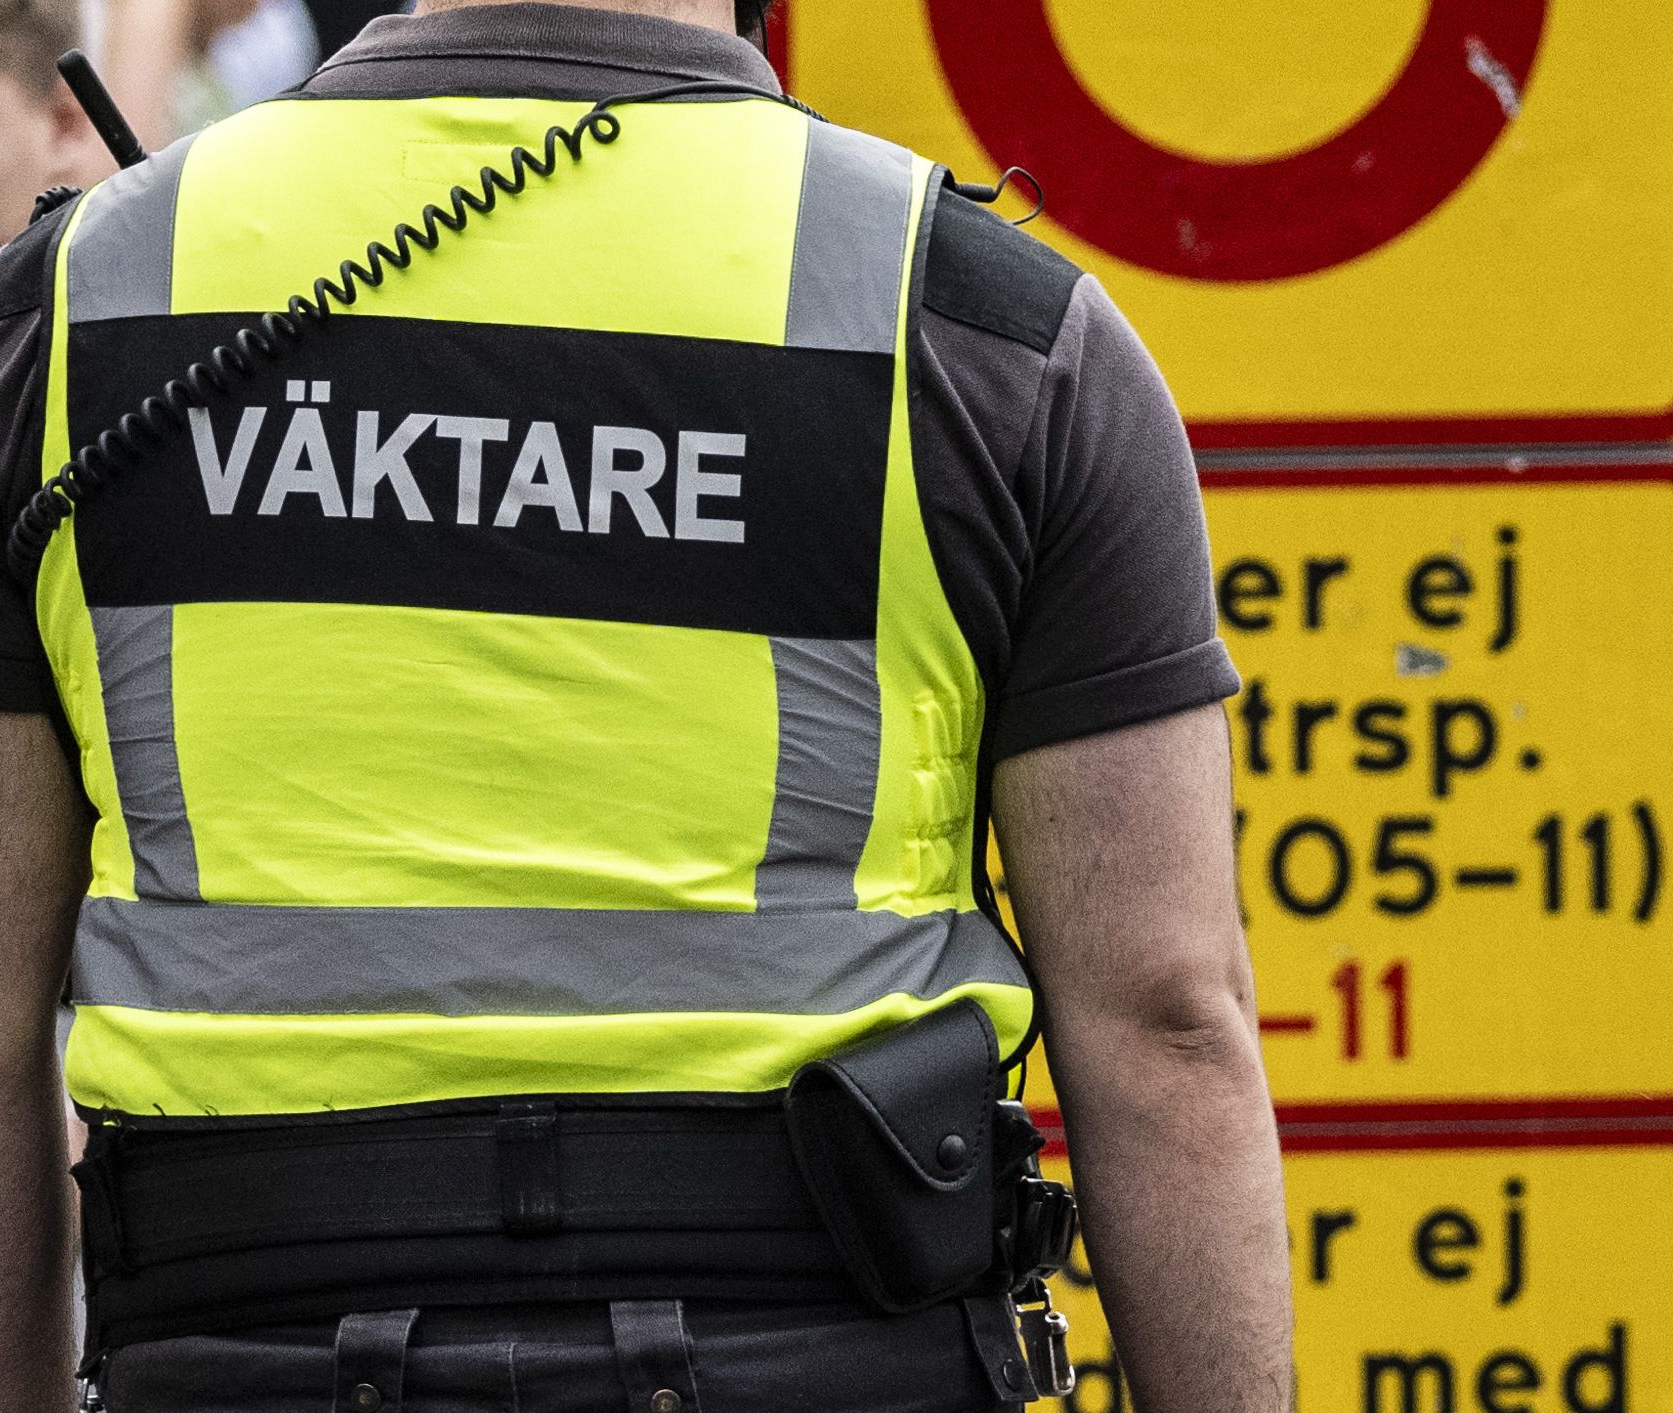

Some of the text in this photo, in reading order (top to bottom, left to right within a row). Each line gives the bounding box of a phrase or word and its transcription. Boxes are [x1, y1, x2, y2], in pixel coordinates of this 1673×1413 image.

[187, 379, 747, 543] VÄKTARE
[1407, 526, 1520, 652] ej
[1241, 678, 1544, 798] trsp.
[1413, 1179, 1527, 1306] ej
